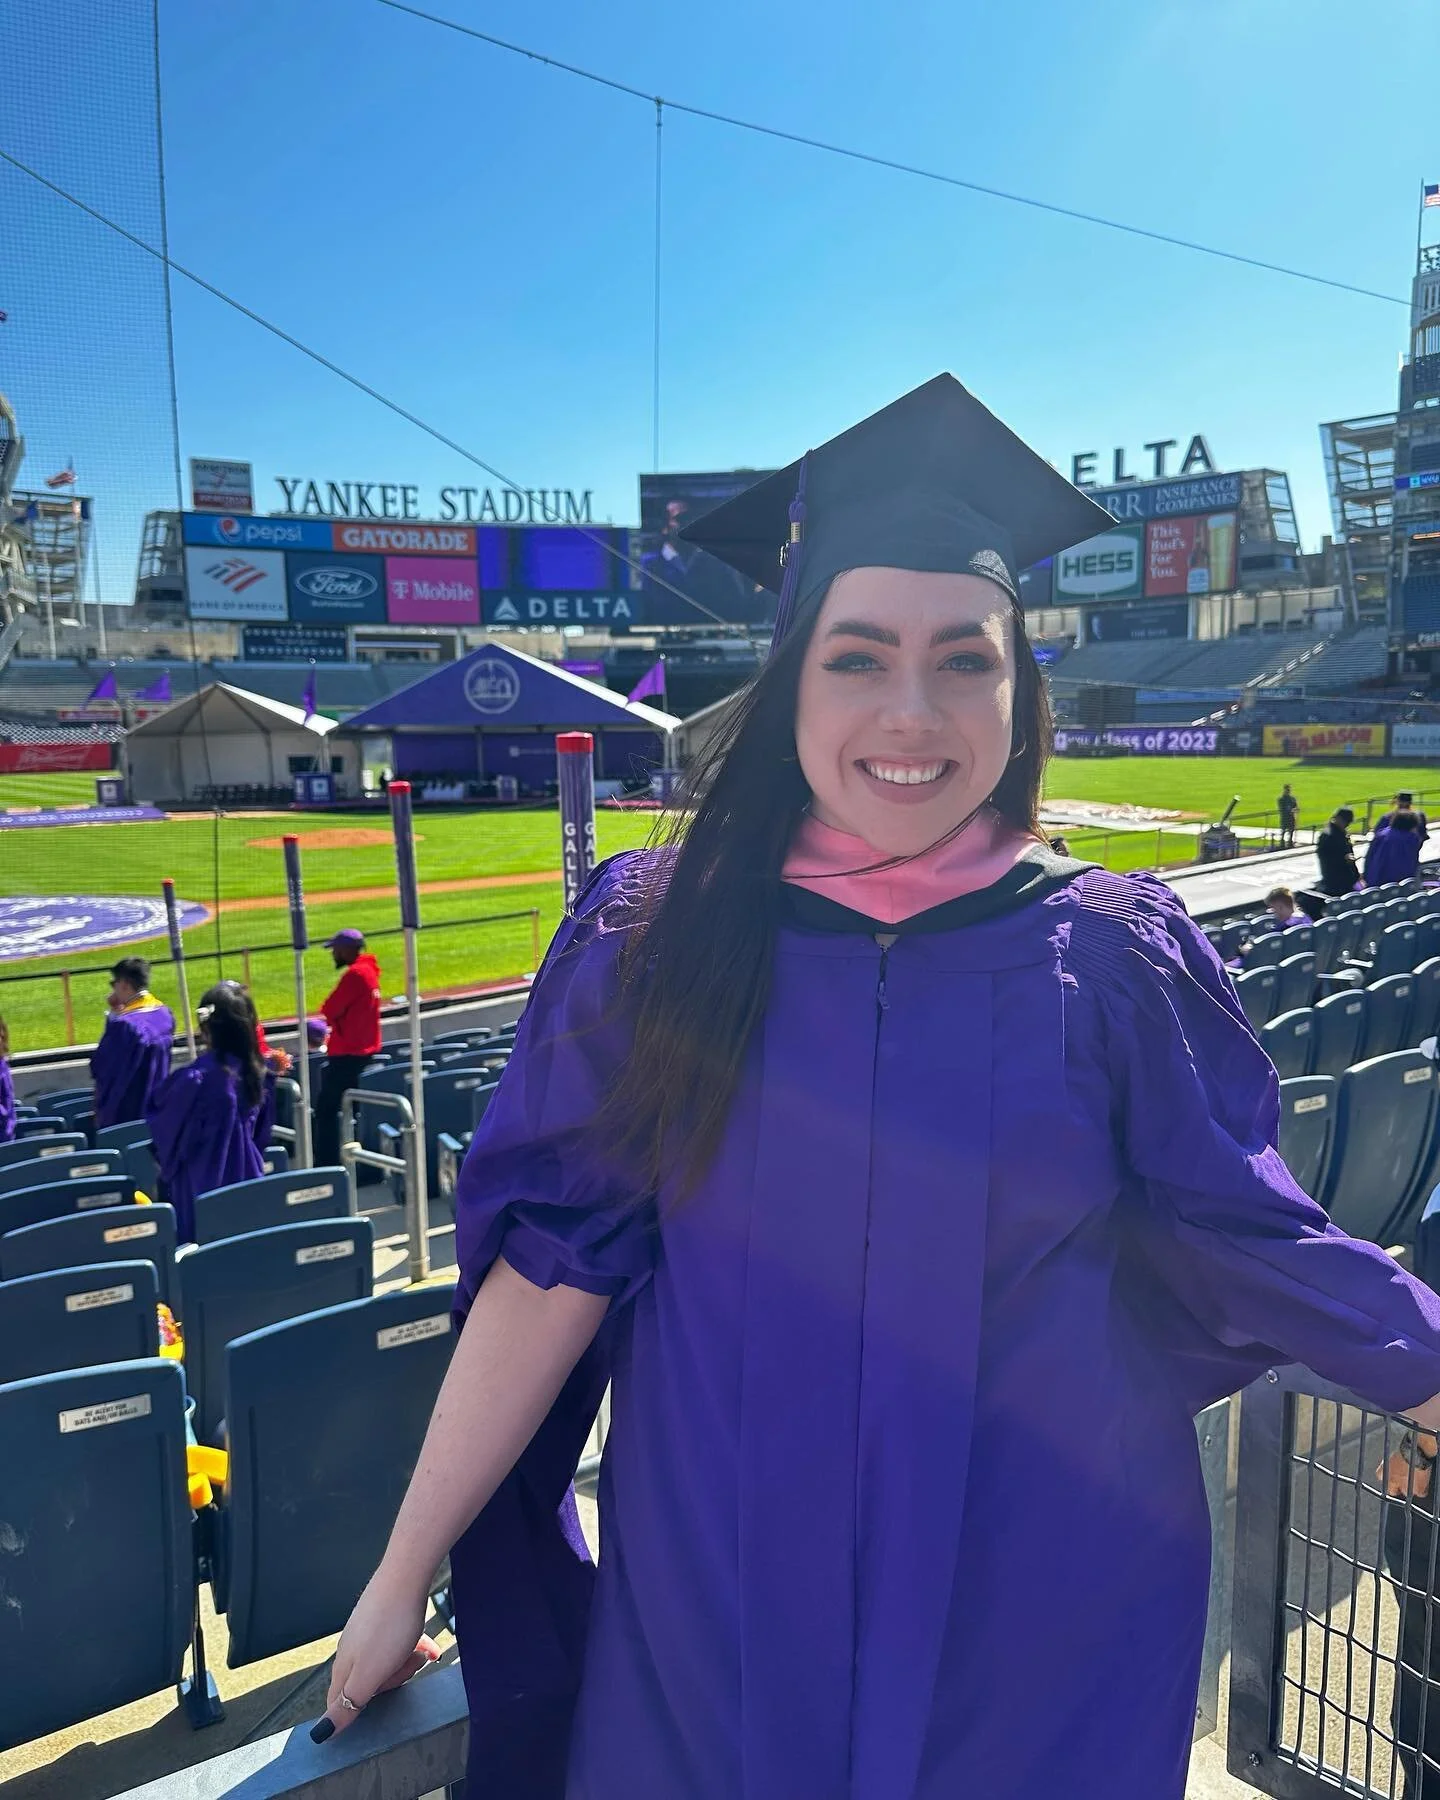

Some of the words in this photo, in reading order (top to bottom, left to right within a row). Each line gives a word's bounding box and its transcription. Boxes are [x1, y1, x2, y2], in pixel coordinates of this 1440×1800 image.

[1072, 435, 1215, 487] ELTA
[1156, 475, 1239, 501] INSURANCE
[274, 476, 420, 519] YANKEE
[440, 486, 594, 524] STADIUM
[1155, 491, 1239, 514] COMPANIES
[246, 524, 303, 544] pepsi
[342, 528, 469, 551] GATORADE
[1151, 525, 1181, 538] This
[1151, 537, 1185, 550] Bud's
[1063, 551, 1134, 578] HESS
[1151, 554, 1173, 564] For
[309, 571, 363, 595] Ford
[1151, 567, 1177, 578] You.
[413, 579, 474, 601] Mobile
[528, 596, 632, 619] DELTA
[1143, 730, 1164, 749] of
[1167, 730, 1217, 750] 2023
